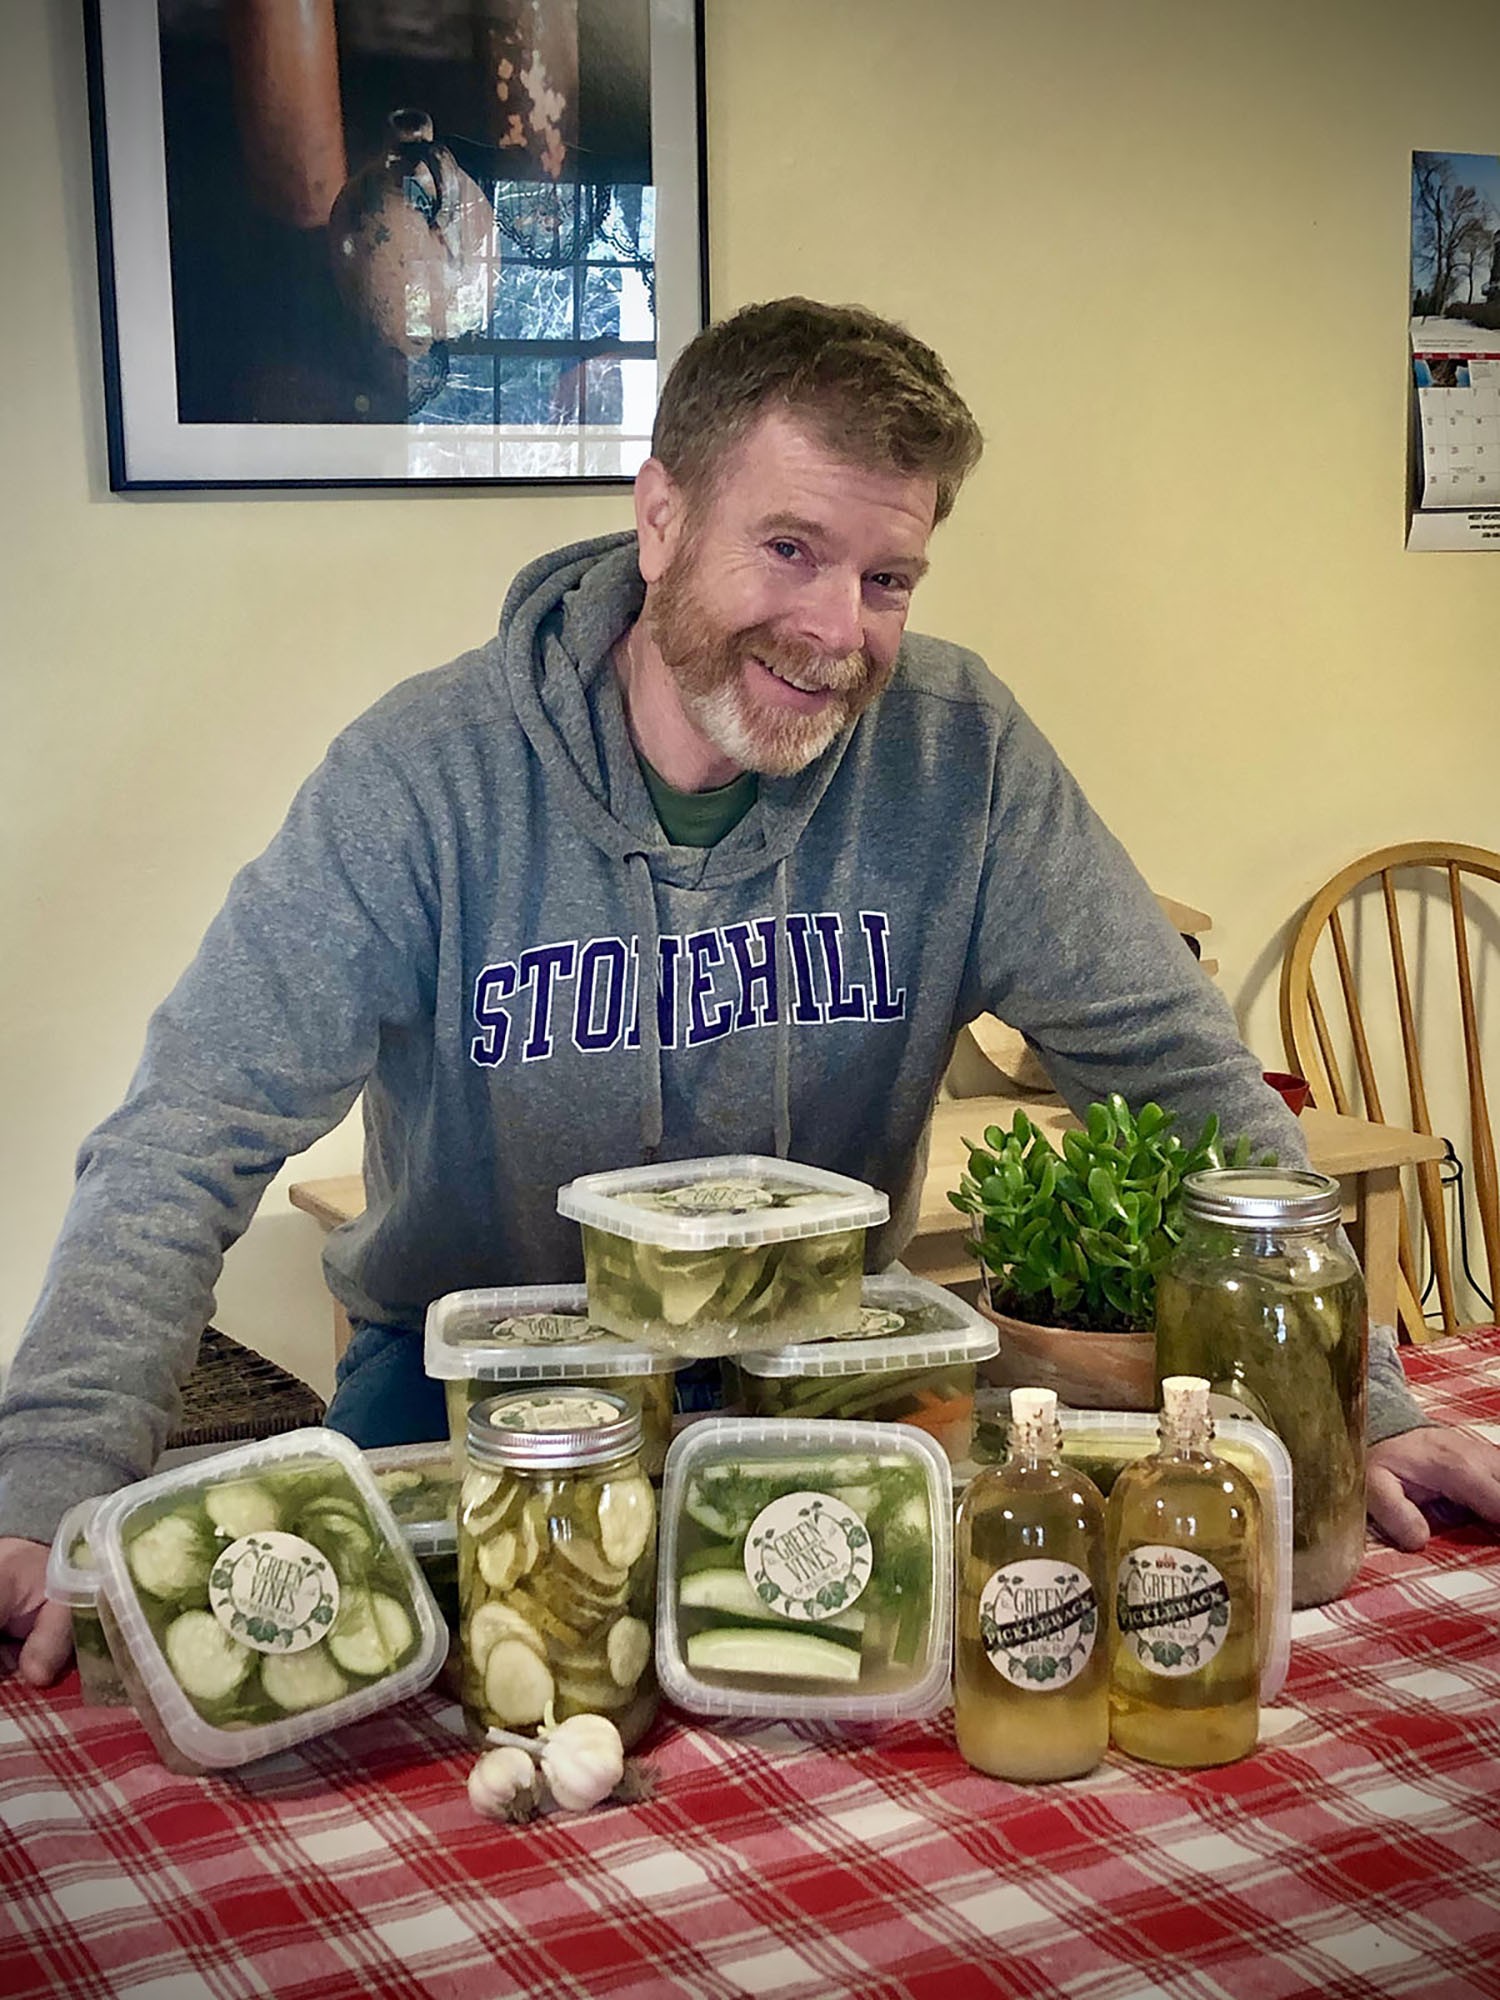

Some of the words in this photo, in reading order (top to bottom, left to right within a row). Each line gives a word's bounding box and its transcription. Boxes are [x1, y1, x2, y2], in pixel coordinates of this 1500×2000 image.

[470, 910, 907, 1068] STONEHILL
[774, 1517, 822, 1560] GREEN
[255, 1553, 307, 1590] GREEN
[785, 1539, 838, 1582] VINES
[1155, 1559, 1178, 1570] HOT
[250, 1575, 296, 1614] VINES
[1013, 1588, 1064, 1614] GREEN
[1142, 1573, 1190, 1598] GREEN
[986, 1594, 1093, 1644] PICKLEBACK
[1121, 1589, 1225, 1626] PICKLEBACK
